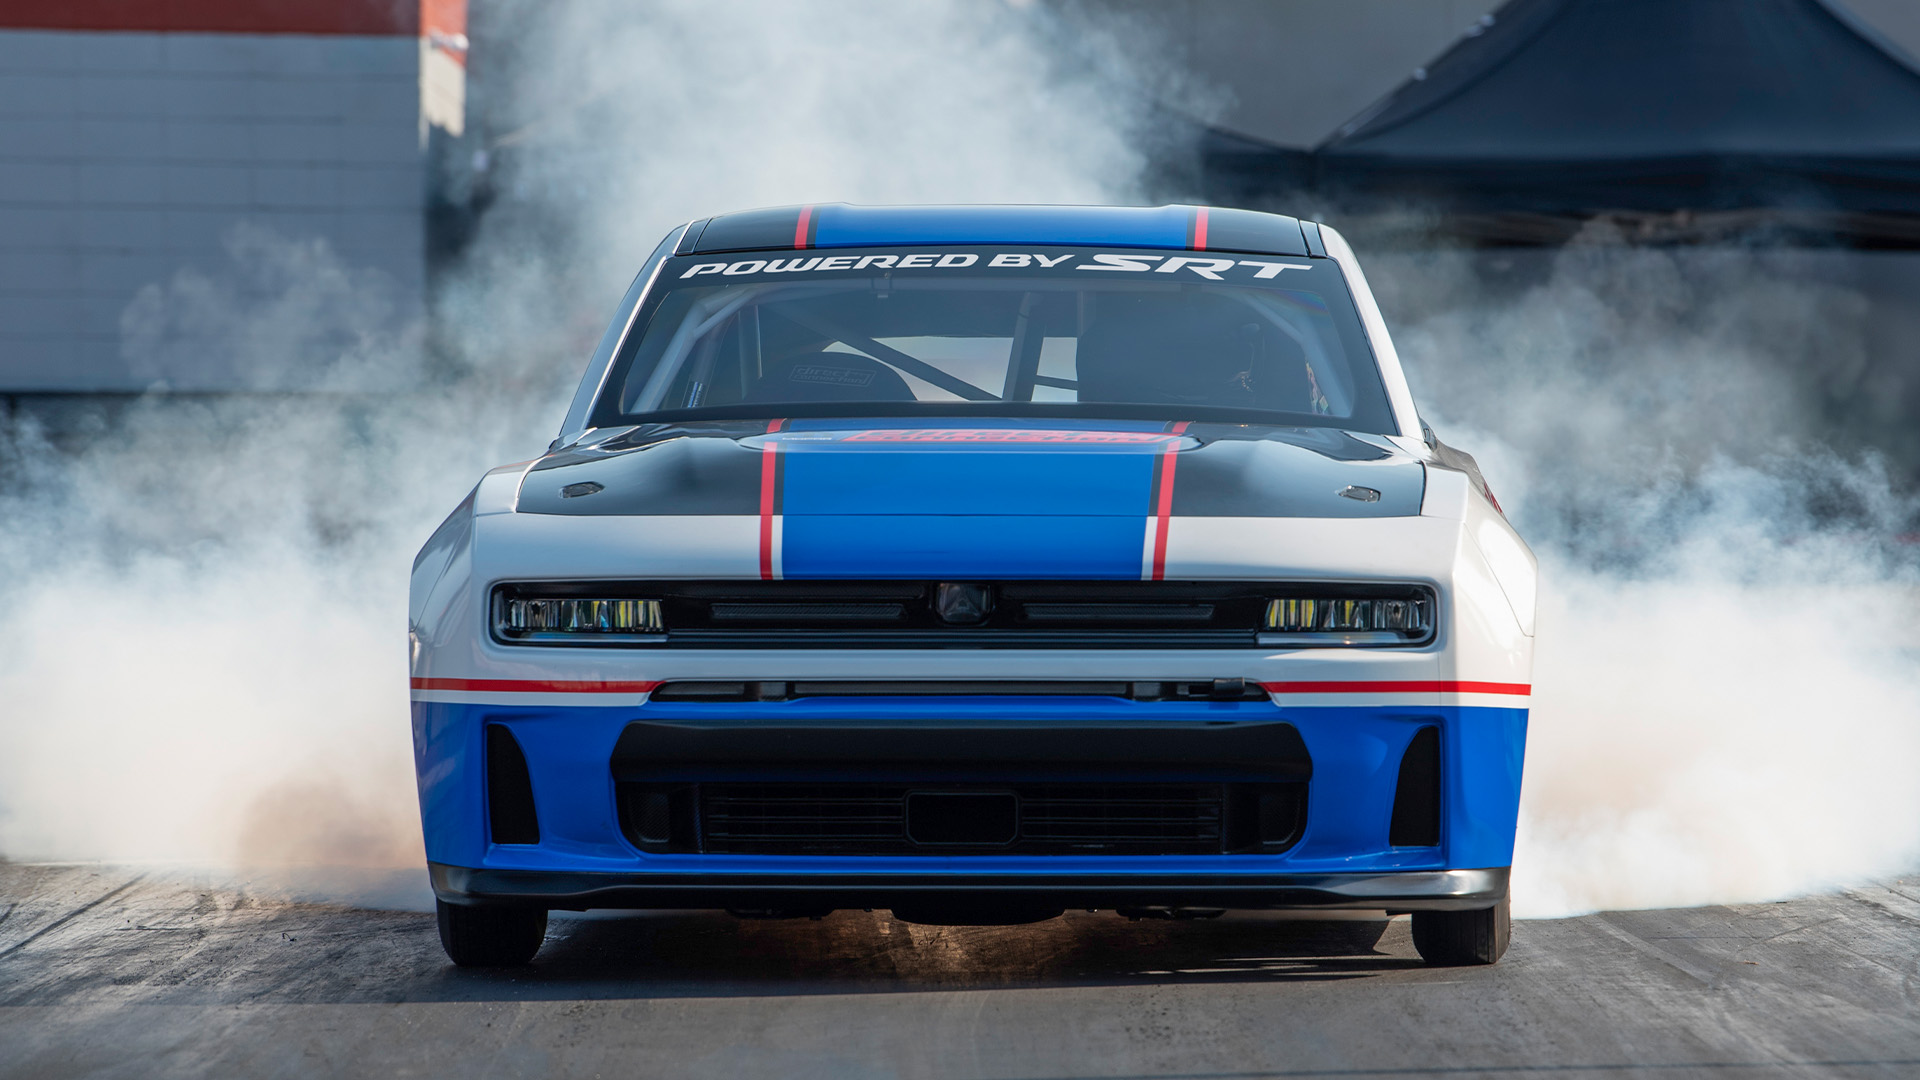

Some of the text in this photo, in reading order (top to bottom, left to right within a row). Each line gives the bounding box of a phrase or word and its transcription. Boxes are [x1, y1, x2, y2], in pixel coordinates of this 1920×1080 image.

[679, 253, 1314, 281] POWERED BY SRT
